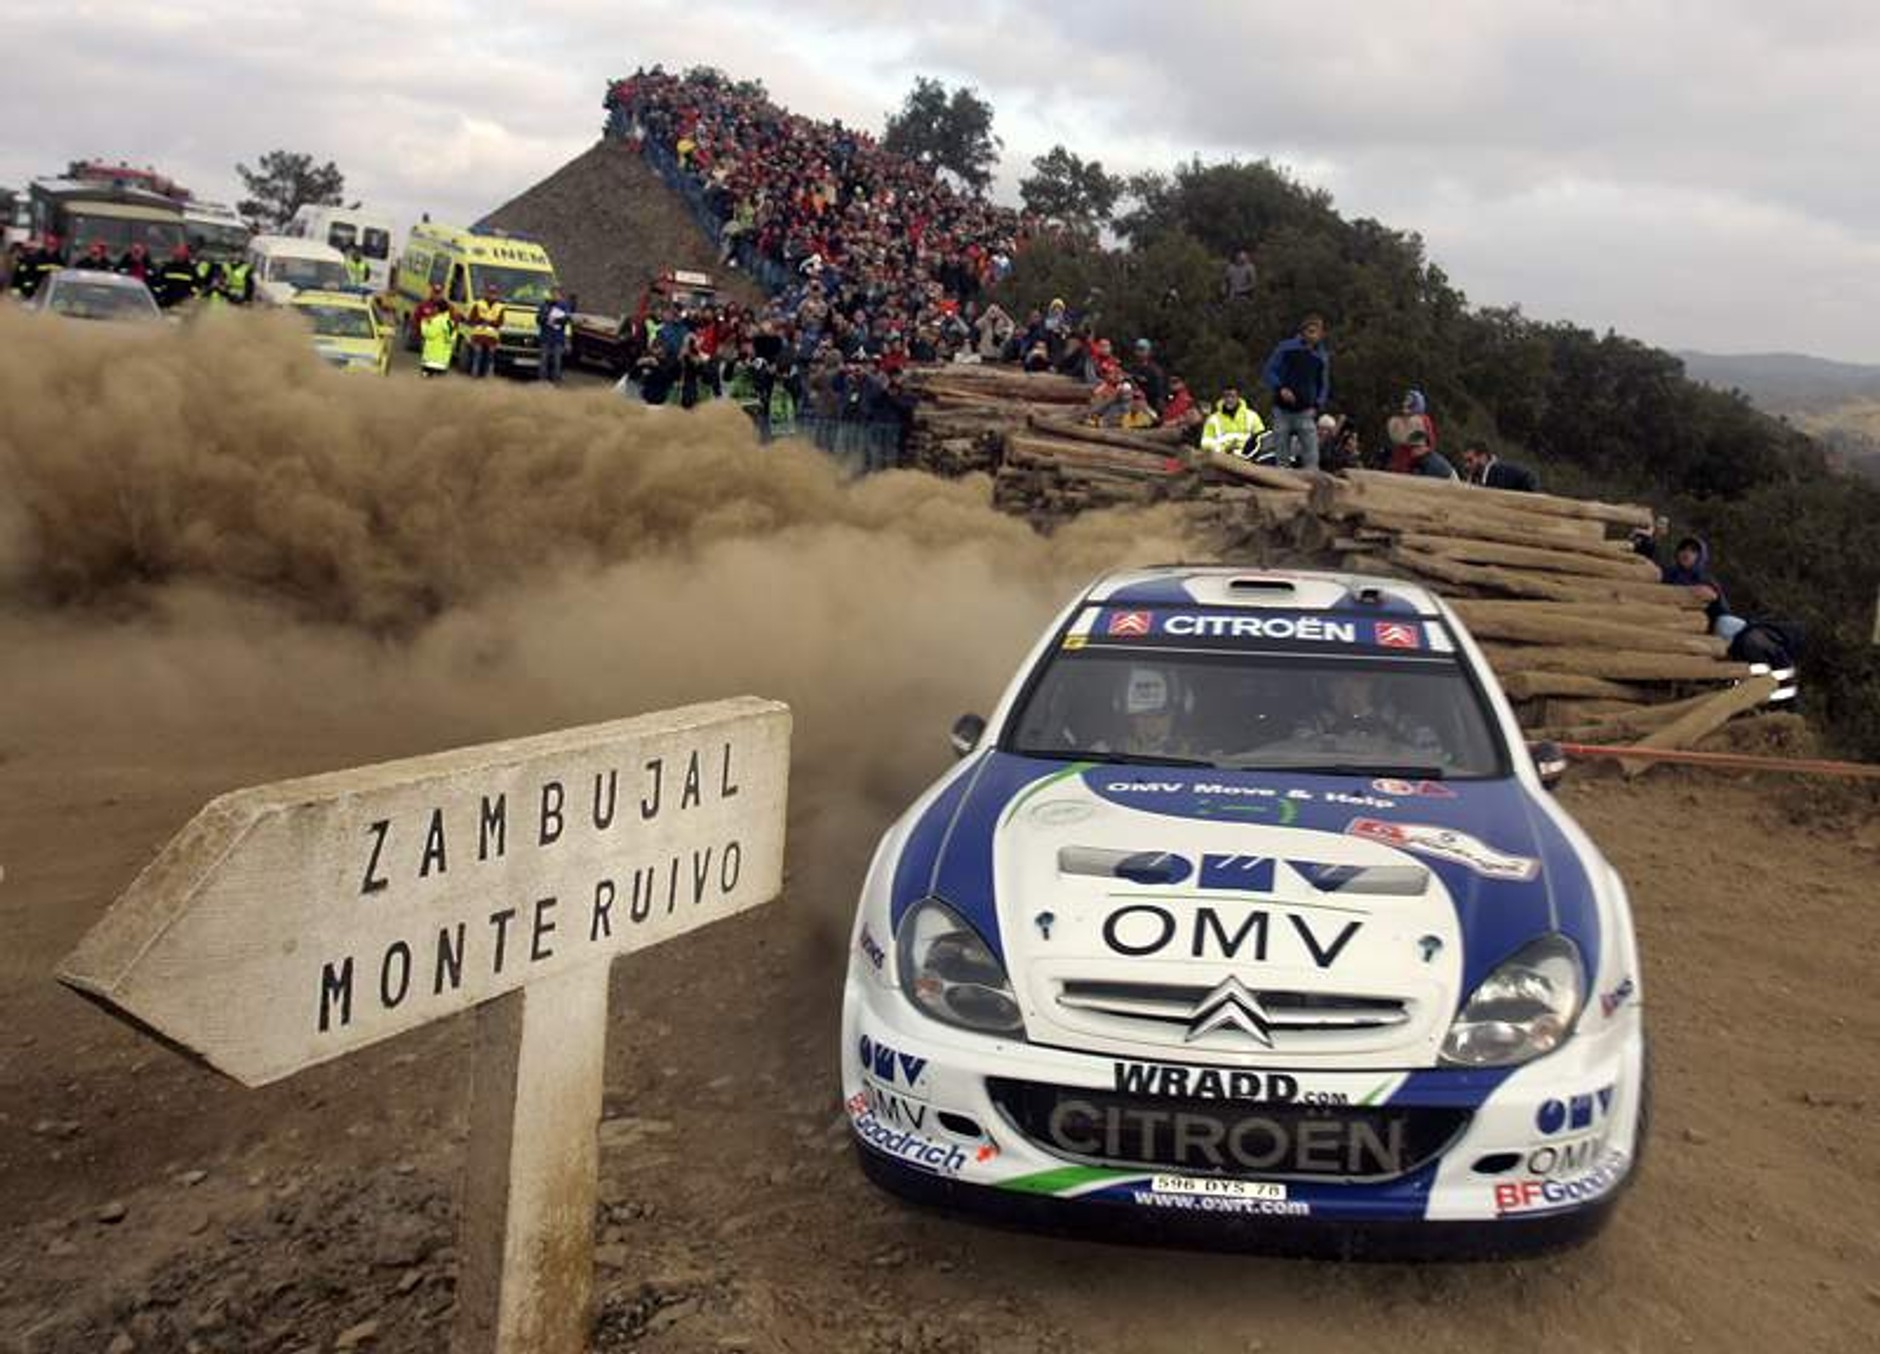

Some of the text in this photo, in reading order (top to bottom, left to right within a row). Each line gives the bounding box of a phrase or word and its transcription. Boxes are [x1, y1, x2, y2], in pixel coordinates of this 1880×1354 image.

[1163, 615, 1354, 643] CITROËN
[361, 743, 739, 894] ZAMBUJAL
[1107, 782, 1183, 793] OMV
[1193, 784, 1276, 797] Move
[1286, 789, 1313, 800] &
[318, 841, 741, 1033] MONTE RUIVO
[1102, 904, 1364, 969] OMV
[1051, 1099, 1401, 1173] CITROËN
